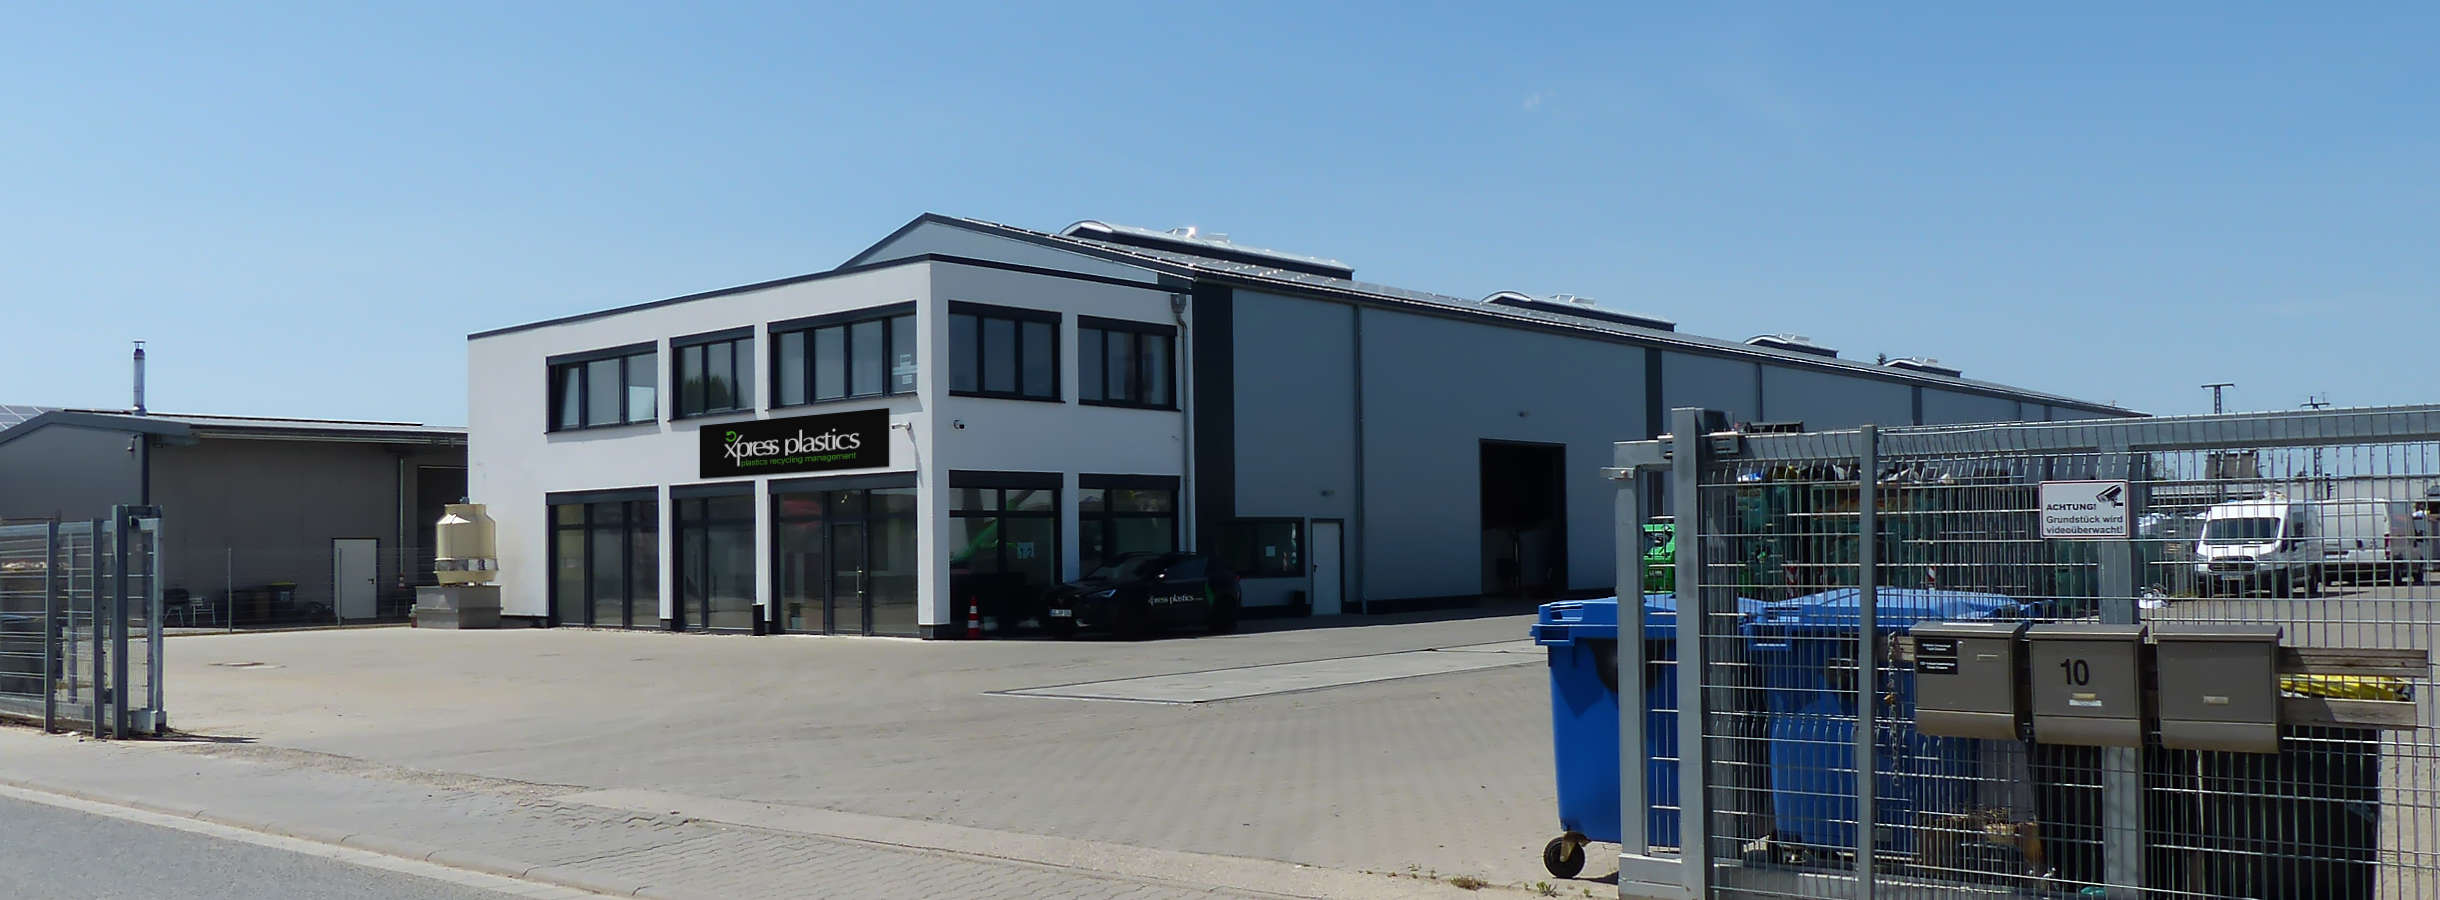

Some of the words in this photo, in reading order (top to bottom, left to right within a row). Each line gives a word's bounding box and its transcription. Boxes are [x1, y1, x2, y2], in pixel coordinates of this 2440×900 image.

[784, 428, 861, 456] plastics
[741, 458, 768, 468] plastics
[770, 454, 803, 465] recycling
[804, 452, 857, 463] management
[2046, 503, 2096, 511] ACHTUNG!
[2046, 515, 2099, 523] Grundstück
[2102, 515, 2123, 523] wird
[2046, 525, 2123, 534] videoüberwacht!
[2060, 658, 2089, 686] 10
